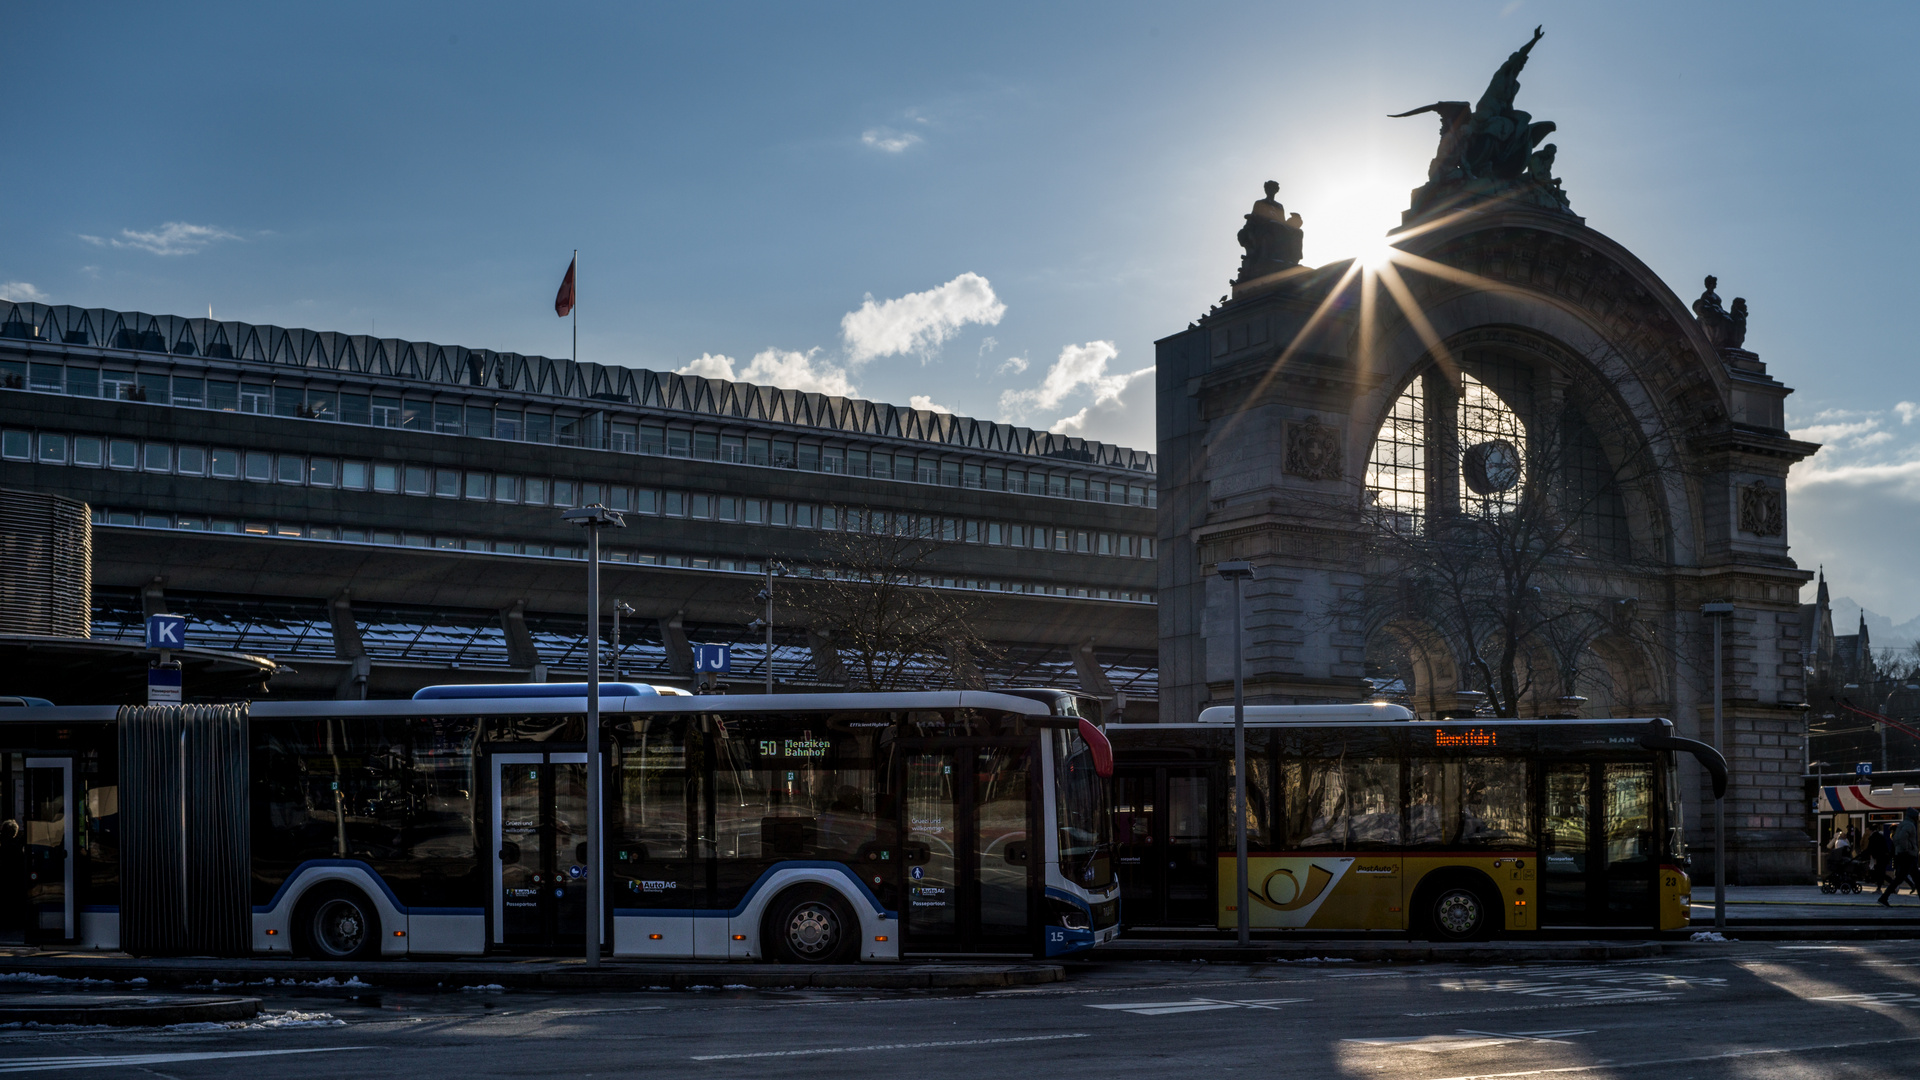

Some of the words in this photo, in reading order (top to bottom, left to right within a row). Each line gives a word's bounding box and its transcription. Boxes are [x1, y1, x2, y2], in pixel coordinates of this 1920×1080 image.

[159, 621, 179, 643] K
[710, 648, 724, 669] J
[1436, 729, 1497, 746] Dienstfahrt
[760, 740, 777, 756] 50
[784, 739, 831, 748] Menziken
[784, 748, 826, 757] Bahnhof
[1863, 764, 1871, 774] G
[1665, 877, 1677, 887] 23
[1050, 932, 1065, 942] 15
